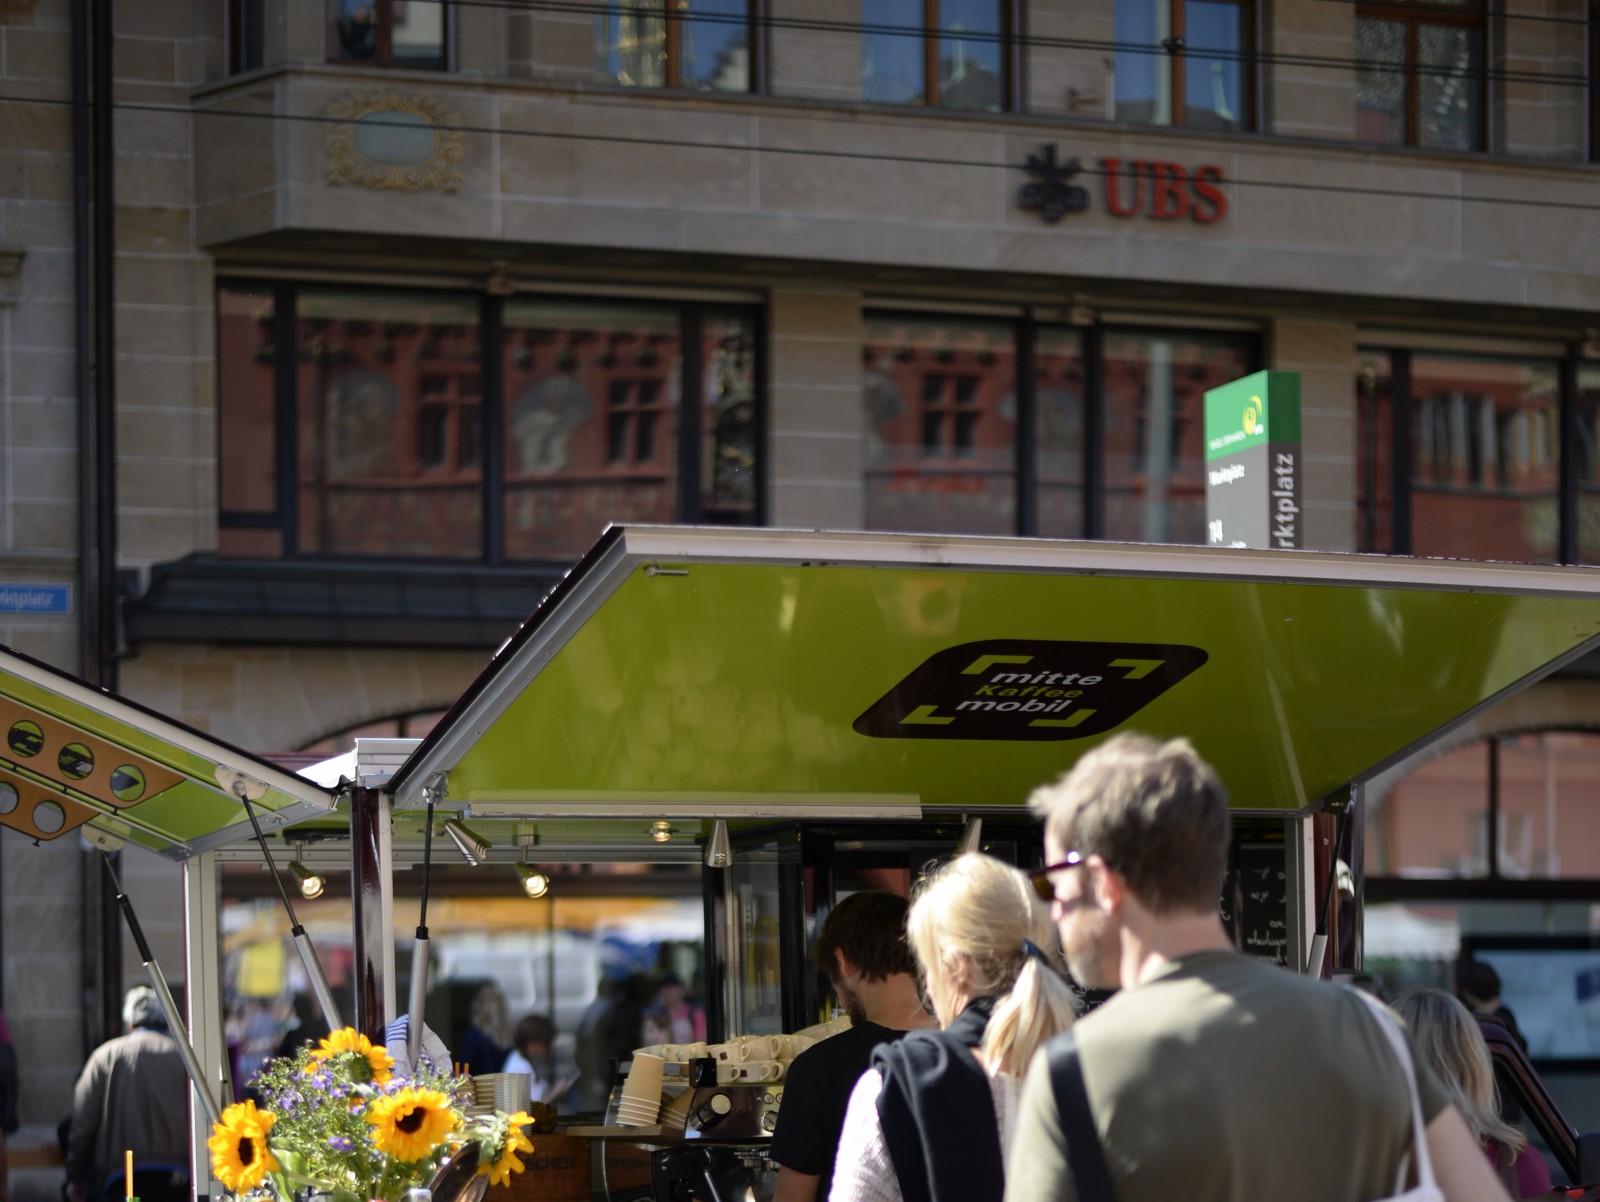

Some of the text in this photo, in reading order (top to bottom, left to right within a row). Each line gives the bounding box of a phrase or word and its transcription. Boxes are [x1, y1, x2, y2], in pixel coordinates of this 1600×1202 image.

[1100, 157, 1228, 223] UBS
[990, 671, 1103, 687] mitte
[974, 684, 1084, 699] Kaffee
[956, 698, 1074, 714] mobil
